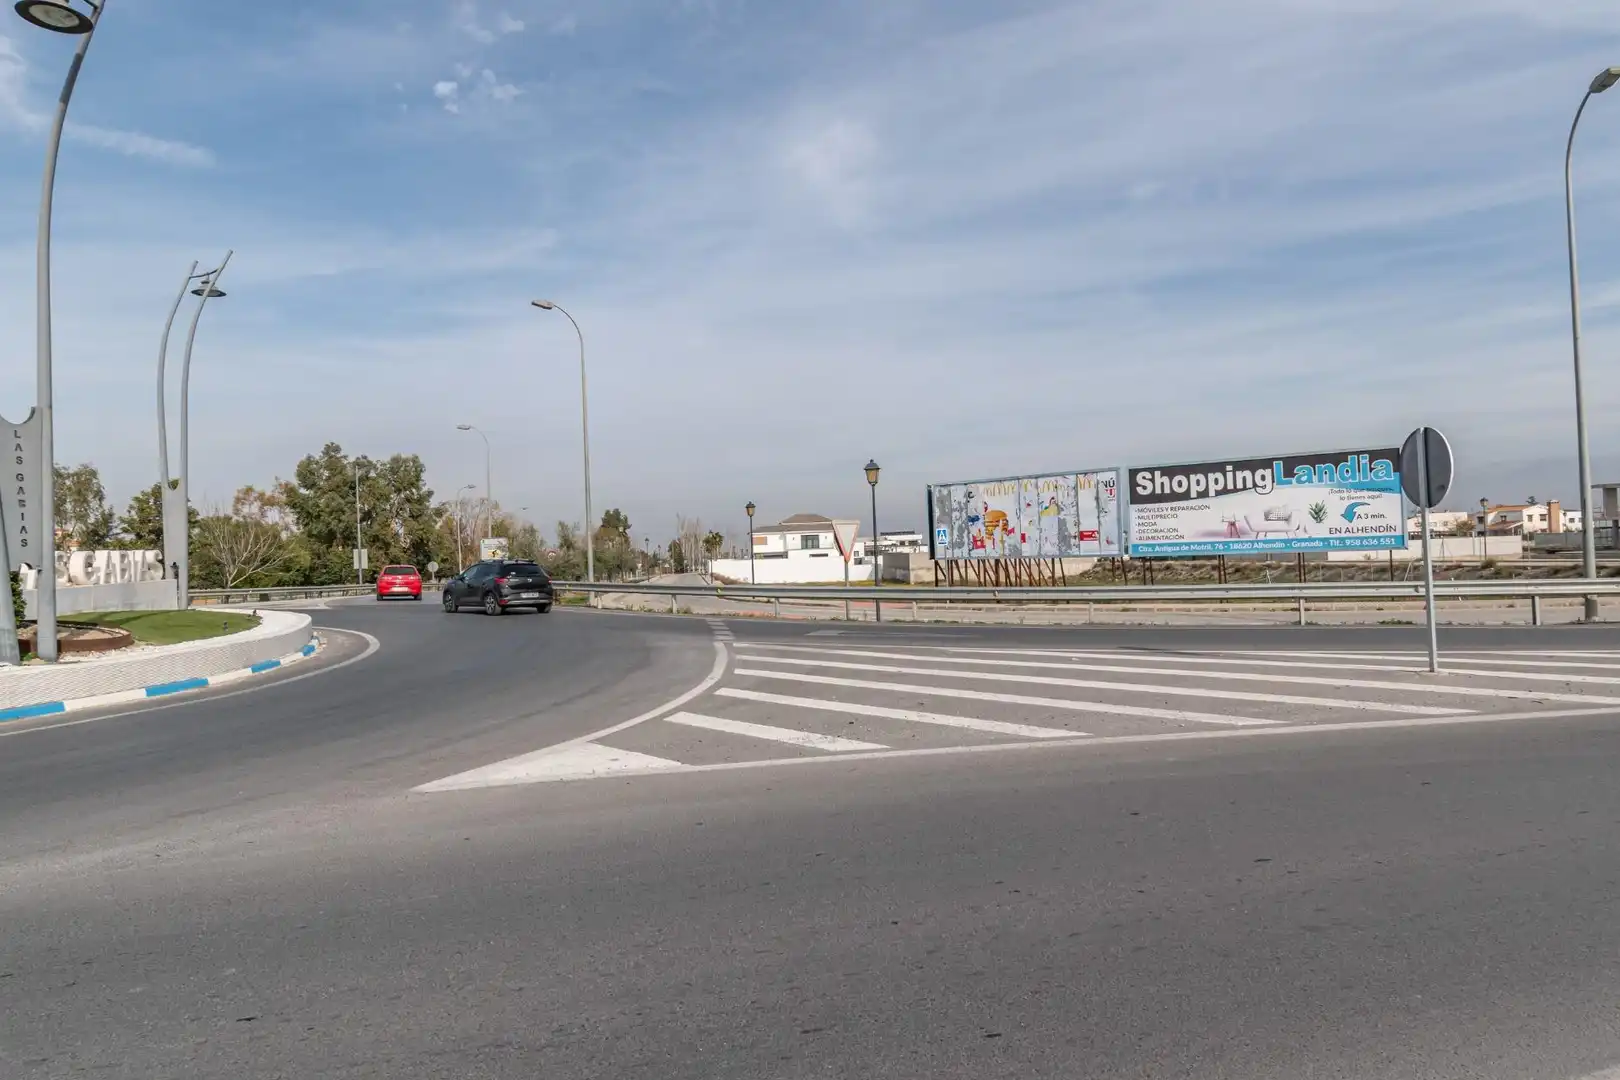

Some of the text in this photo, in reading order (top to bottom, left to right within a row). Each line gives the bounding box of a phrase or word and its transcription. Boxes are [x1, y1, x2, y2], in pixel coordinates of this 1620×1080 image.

[13, 429, 28, 548] LAS GABIAS
[1344, 524, 1397, 534] ALHENDÍN
